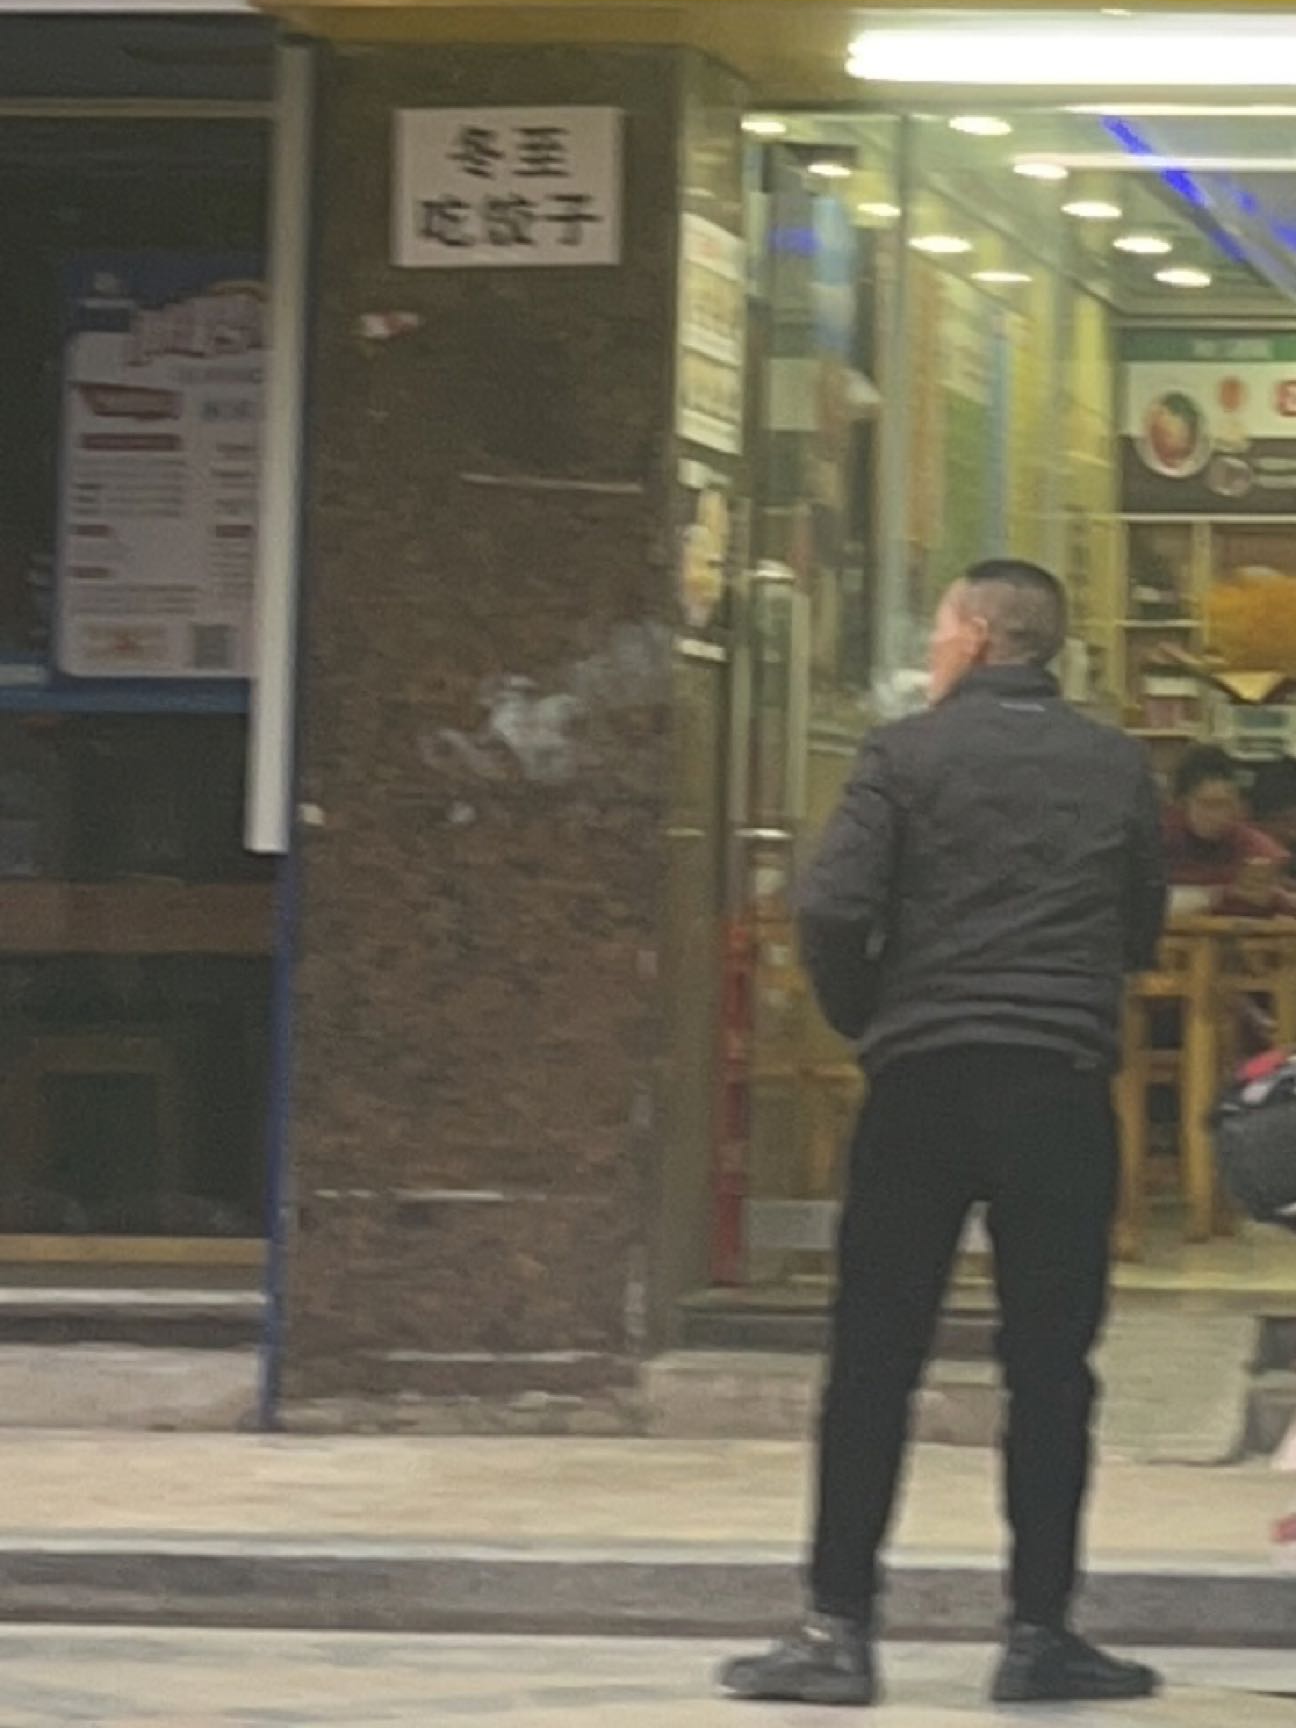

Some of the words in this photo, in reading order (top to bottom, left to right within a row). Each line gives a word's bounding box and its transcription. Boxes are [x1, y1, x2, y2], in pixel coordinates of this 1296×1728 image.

[446, 125, 571, 181] 冬至
[418, 192, 605, 248] 吃饺子
